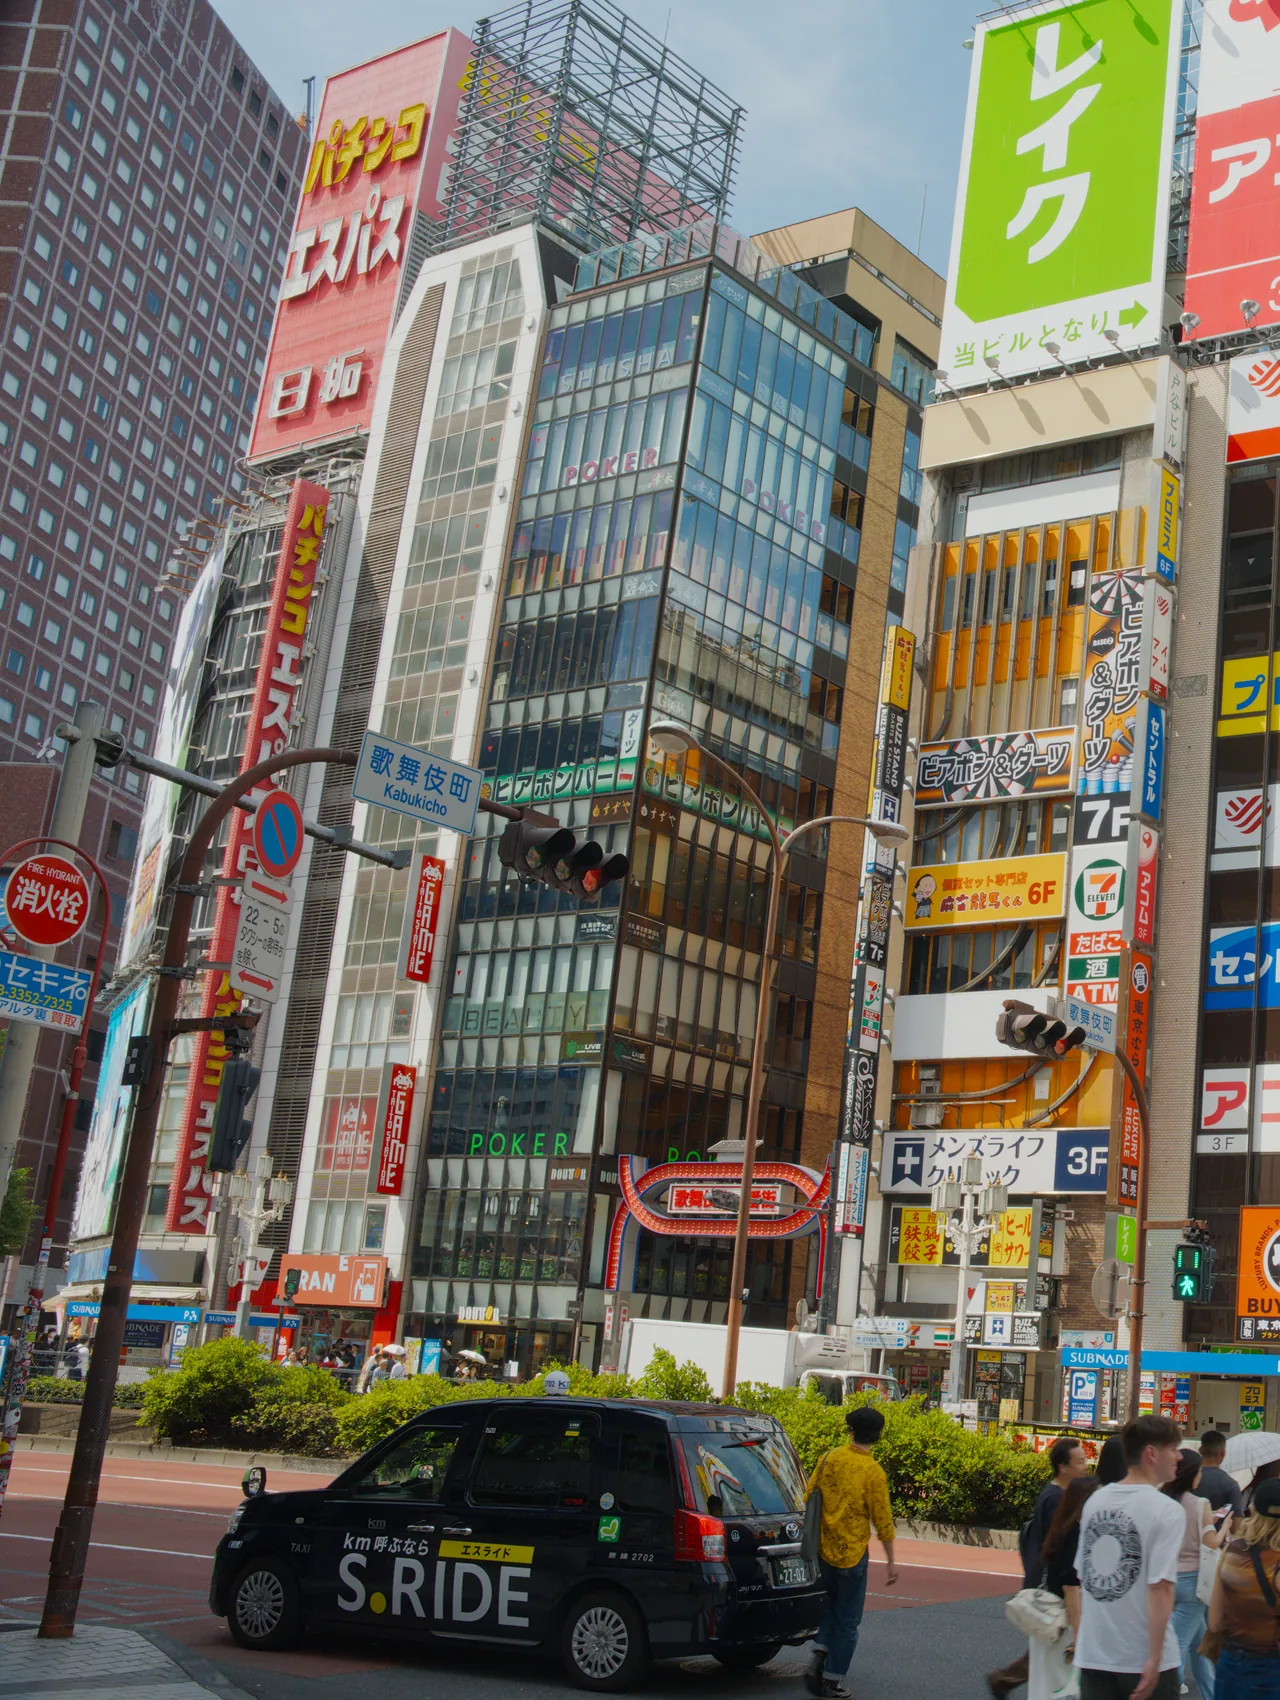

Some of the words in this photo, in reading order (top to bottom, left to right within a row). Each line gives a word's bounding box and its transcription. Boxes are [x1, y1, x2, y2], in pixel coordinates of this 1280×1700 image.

[304, 103, 427, 194] パチンコ
[1006, 22, 1103, 264] レイク
[281, 190, 406, 302] エスパス
[954, 311, 1109, 369] 当ビルとなり
[560, 352, 674, 394] SHISHA
[755, 382, 806, 424] BAR
[564, 447, 658, 486] POKER
[743, 477, 825, 542] POKER
[1162, 480, 1176, 552] プロミス
[280, 502, 326, 636] パチンコ
[1160, 558, 1172, 575] 6F
[624, 712, 641, 754] ダーツ
[370, 744, 473, 804] 歌舞伎町
[1146, 717, 1160, 804] セントラル
[494, 768, 614, 802] ビアポンバー
[384, 783, 448, 817] Kabukicho
[1080, 799, 1130, 840] 7F
[28, 862, 45, 876] FIRE
[46, 867, 81, 885] HYDRANT
[942, 871, 1028, 891] 個室セット専門店
[12, 876, 84, 925] 消火栓
[1028, 880, 1056, 905] 6F
[1087, 892, 1116, 903] ELEVEN
[1137, 871, 1151, 925] アコム
[413, 880, 434, 976] GAME
[1137, 928, 1148, 940] 3F
[870, 944, 884, 961] 7F
[1075, 933, 1122, 954] たばこ
[236, 948, 258, 969] を除く
[1085, 958, 1108, 979] 酒
[1071, 983, 1119, 1004] ATM
[51, 1010, 77, 1029] 買取
[463, 1004, 585, 1032] BEAUTY
[1069, 1002, 1113, 1036] 歌舞伎町
[386, 1091, 406, 1188] GAME
[470, 1132, 569, 1157] POKER
[929, 1135, 1044, 1158] メンズライフ
[1124, 1107, 1132, 1159] RESALE
[1131, 1108, 1140, 1161] LUXURY
[1211, 1136, 1235, 1151] 3F
[551, 1167, 587, 1181] DOUTOR
[1067, 1147, 1108, 1176] 3F
[892, 1227, 900, 1244] 2F
[904, 1224, 940, 1243] 鉄鍋
[1006, 1214, 1031, 1238] ビール
[1120, 1218, 1131, 1256] レイク
[903, 1243, 939, 1262] 餃子
[1004, 1241, 1030, 1265] サワー
[1254, 1226, 1274, 1256] BRANDS
[1254, 1259, 1268, 1291] LUXURY
[458, 1305, 501, 1323] DOUTOR
[1070, 1352, 1129, 1366] SUBNADE
[1074, 1376, 1086, 1396] P
[290, 1542, 312, 1554] TAXI
[344, 1532, 371, 1551] km
[374, 1536, 429, 1556] 呼ぶなら
[461, 1545, 512, 1558] エスライド
[631, 1553, 655, 1563] 2702
[337, 1552, 533, 1628] S.RIDE
